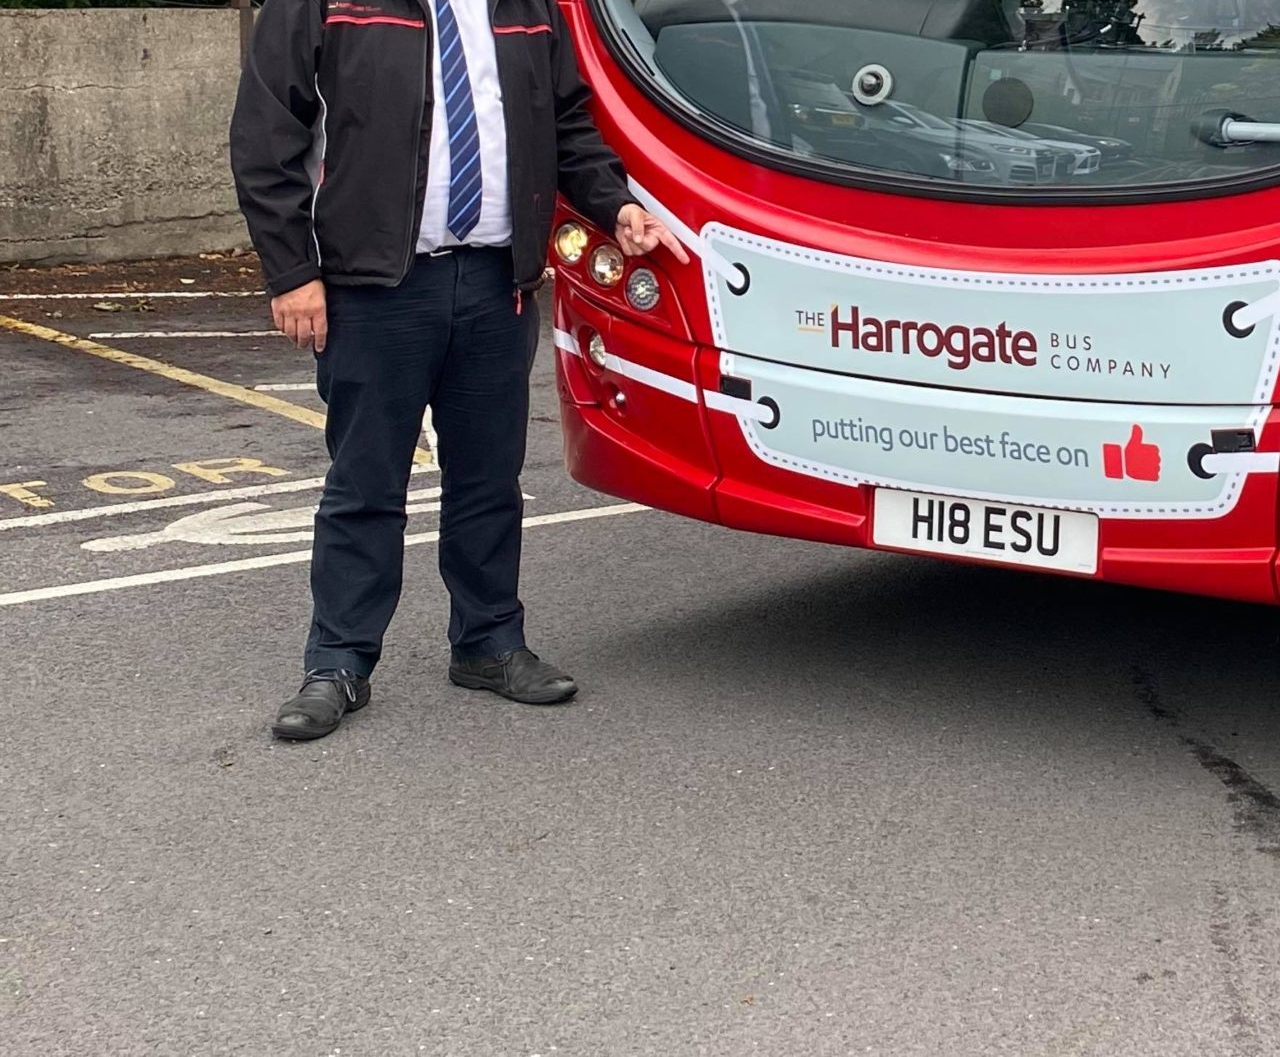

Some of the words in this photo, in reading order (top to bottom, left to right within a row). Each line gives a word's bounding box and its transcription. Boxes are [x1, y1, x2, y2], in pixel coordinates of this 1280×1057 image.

[795, 309, 825, 327] THE
[830, 304, 1038, 370] Harrogate
[1050, 332, 1093, 351] BUS
[1050, 354, 1172, 379] COMPANY
[811, 415, 894, 451] putting
[899, 430, 940, 450] our
[943, 424, 996, 457] best
[999, 433, 1051, 465] face
[1056, 445, 1090, 468] on
[983, 506, 1061, 557] ESU
